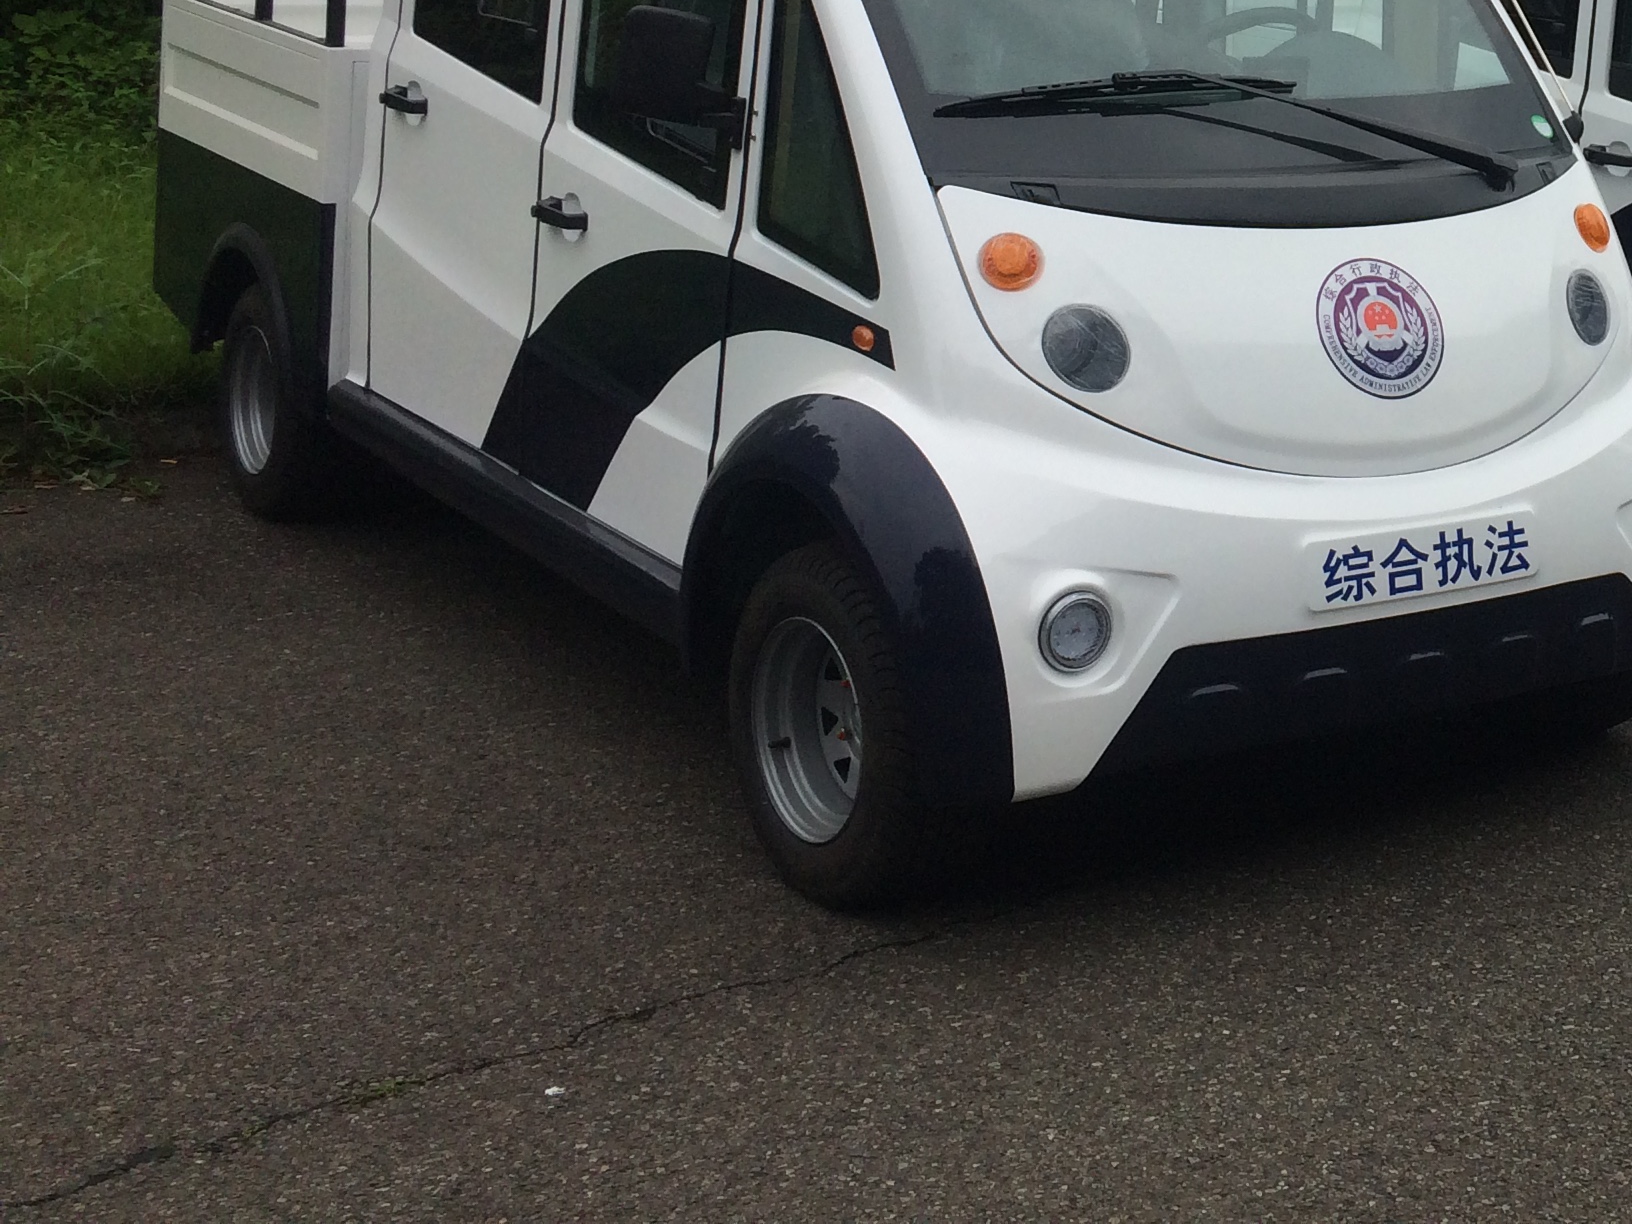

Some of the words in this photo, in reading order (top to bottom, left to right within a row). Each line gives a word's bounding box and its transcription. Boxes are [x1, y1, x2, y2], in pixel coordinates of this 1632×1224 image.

[1323, 263, 1420, 302] 综合行政执法
[1323, 314, 1358, 378] COMPREHENSIVE
[1359, 376, 1421, 393] ADMINISTRATIVE
[1421, 363, 1433, 377] LAW
[1322, 520, 1530, 603] 综合执法
